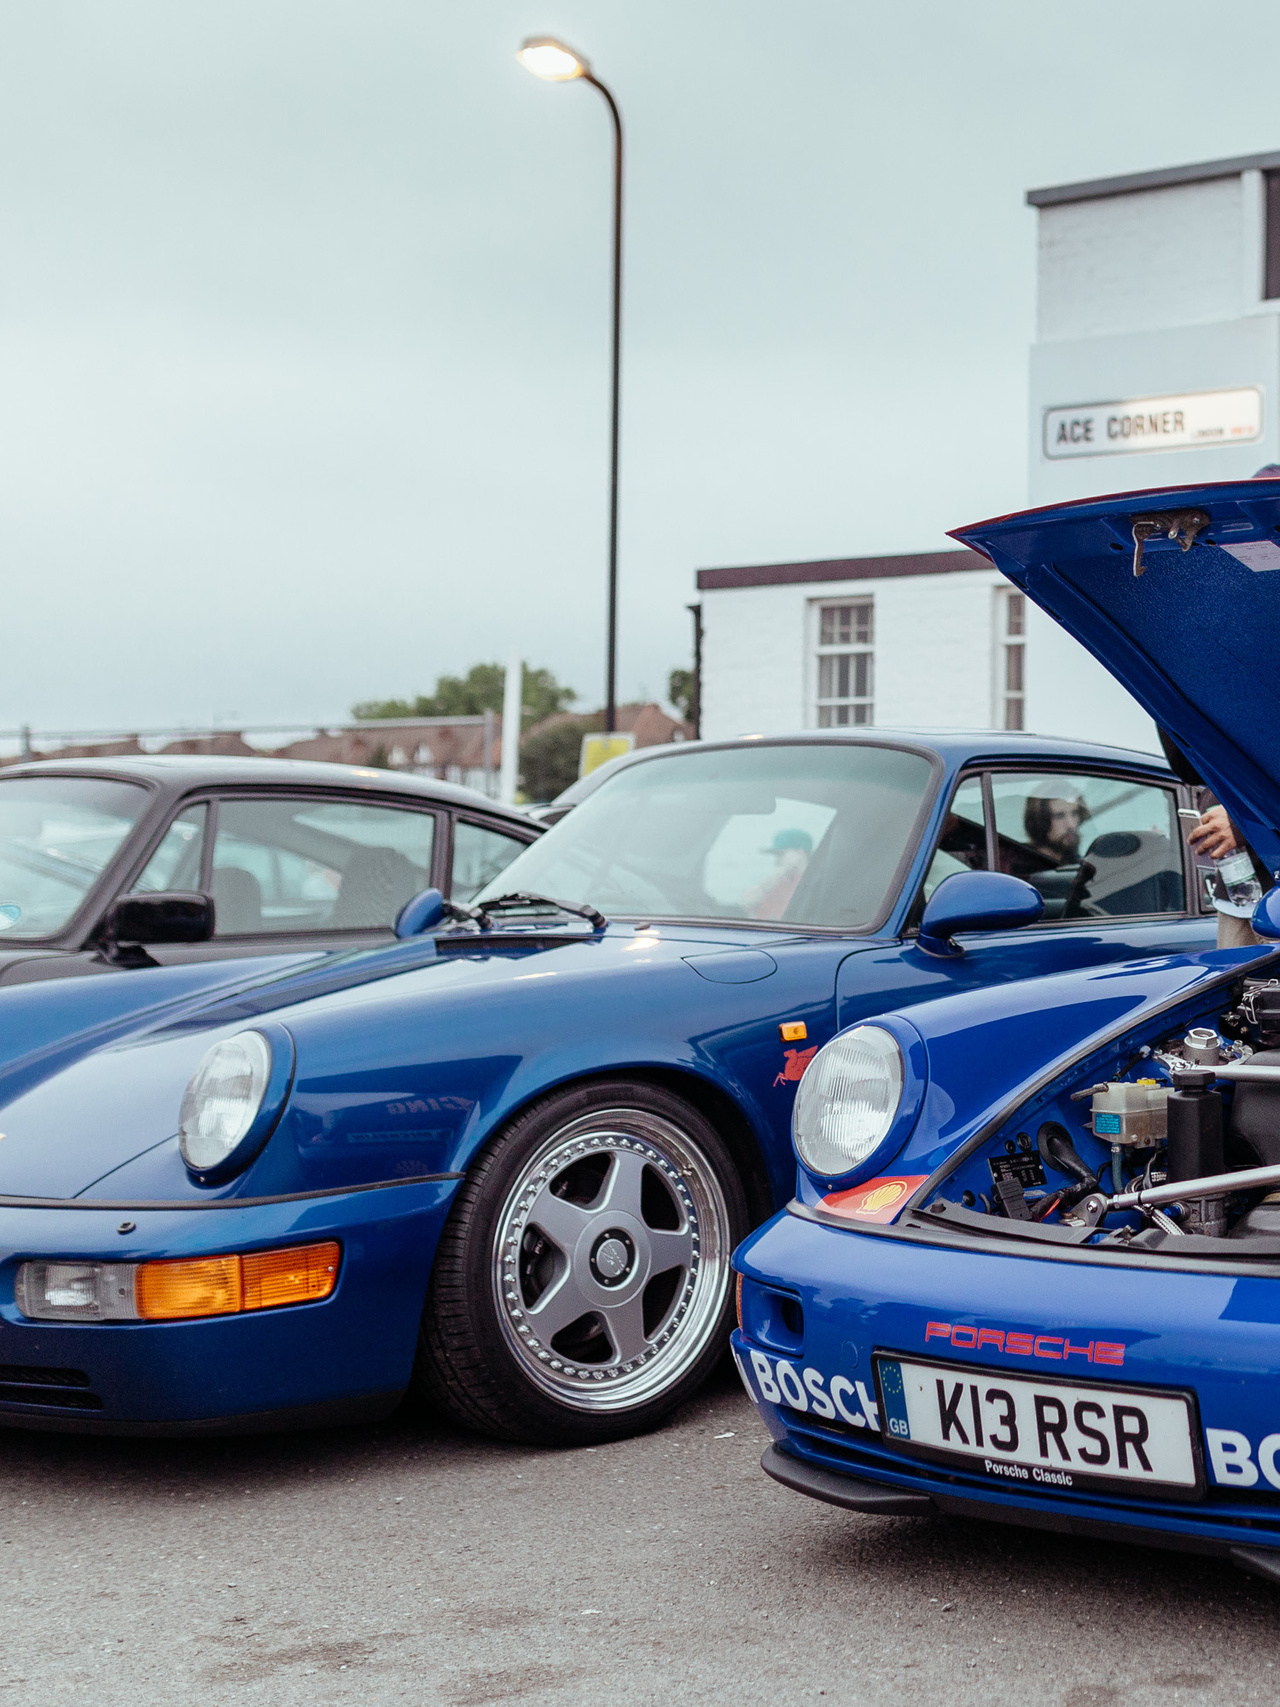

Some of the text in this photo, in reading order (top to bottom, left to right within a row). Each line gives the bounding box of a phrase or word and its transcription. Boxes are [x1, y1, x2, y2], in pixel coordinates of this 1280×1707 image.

[1056, 418, 1095, 444] ACE
[1106, 411, 1186, 439] CORNER
[925, 1321, 1126, 1366] PORSCHE
[888, 1417, 908, 1436] GB
[935, 1378, 1154, 1473] K13 RSR
[984, 1459, 1073, 1487] Porsche Classic
